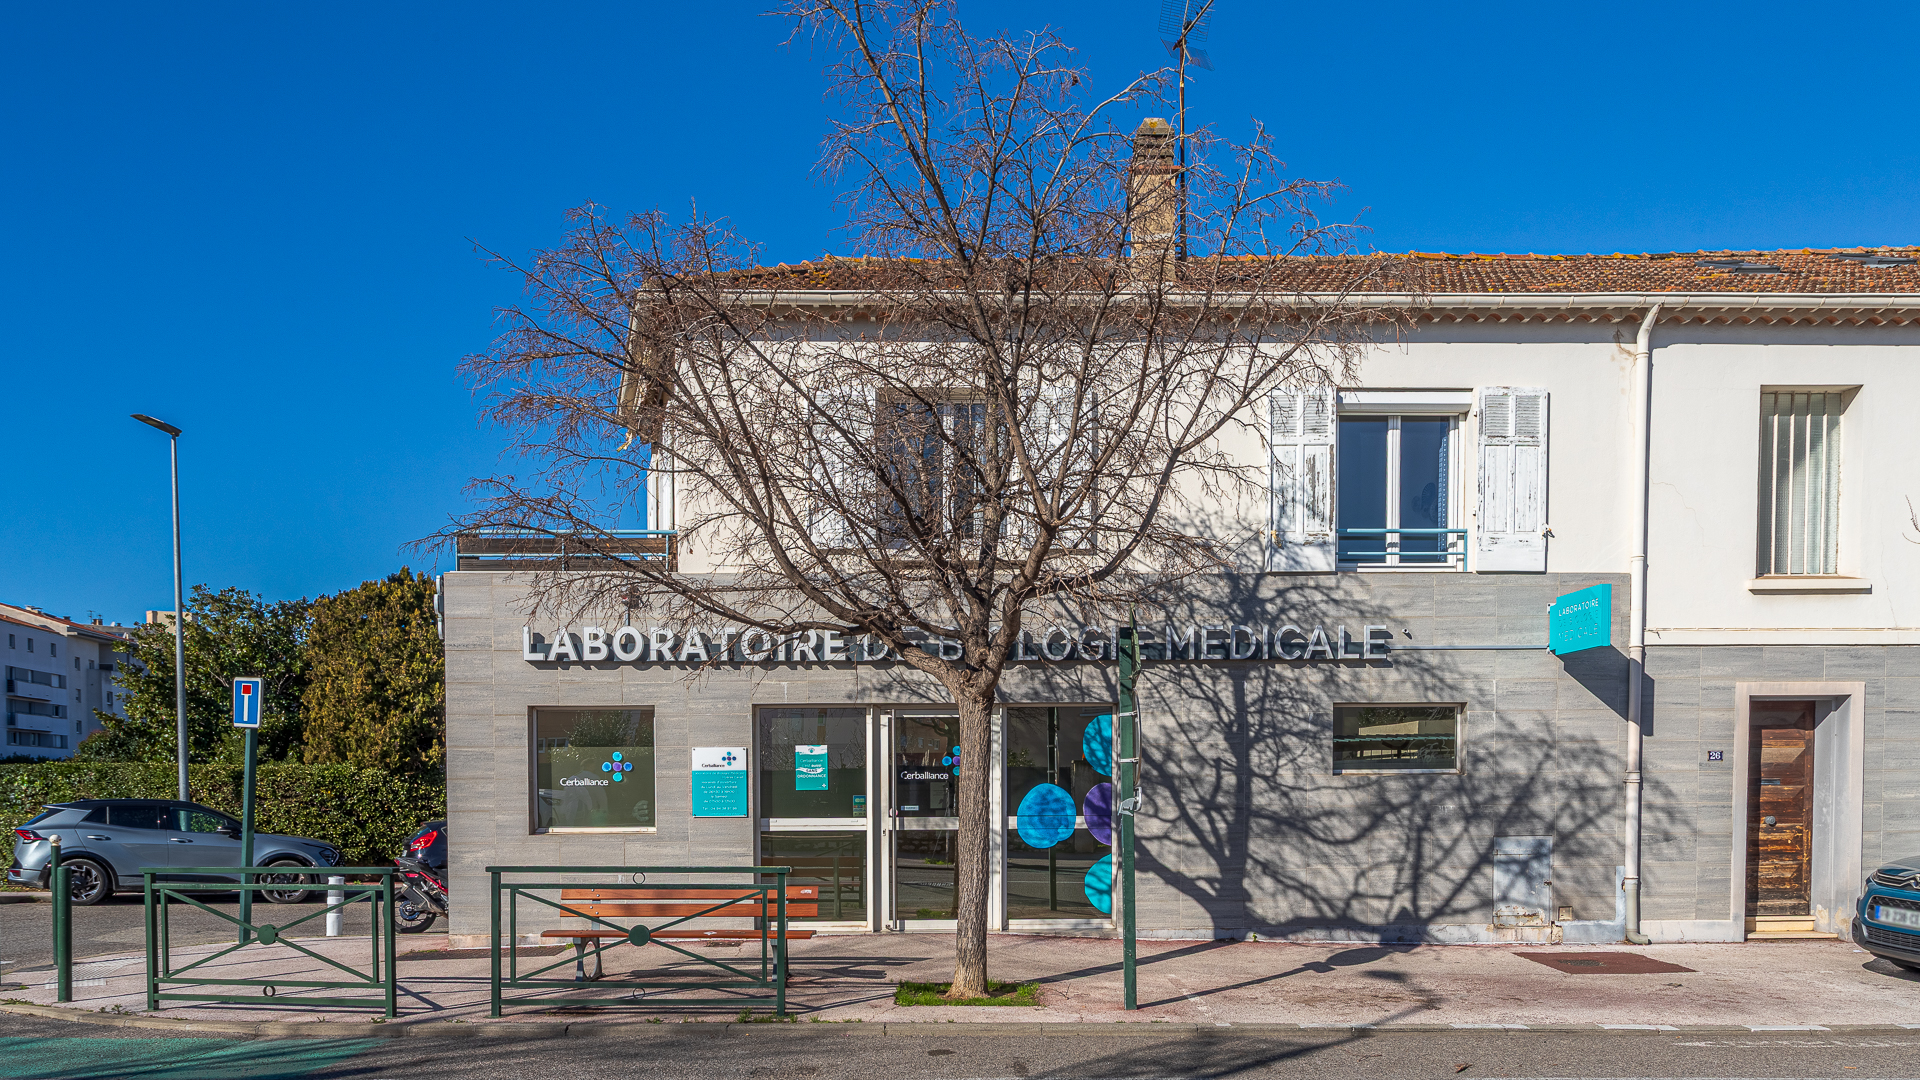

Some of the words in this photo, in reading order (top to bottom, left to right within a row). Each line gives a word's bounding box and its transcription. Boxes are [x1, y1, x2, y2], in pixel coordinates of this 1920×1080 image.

[1558, 597, 1599, 617] LABORATOIRE
[523, 626, 846, 661] LABORATOIRE
[938, 625, 1147, 661] BLOGI
[1166, 625, 1388, 660] MEDICALE
[1709, 751, 1721, 761] 26
[900, 771, 949, 780] Cerballiance
[559, 777, 609, 787] Cerballiance
